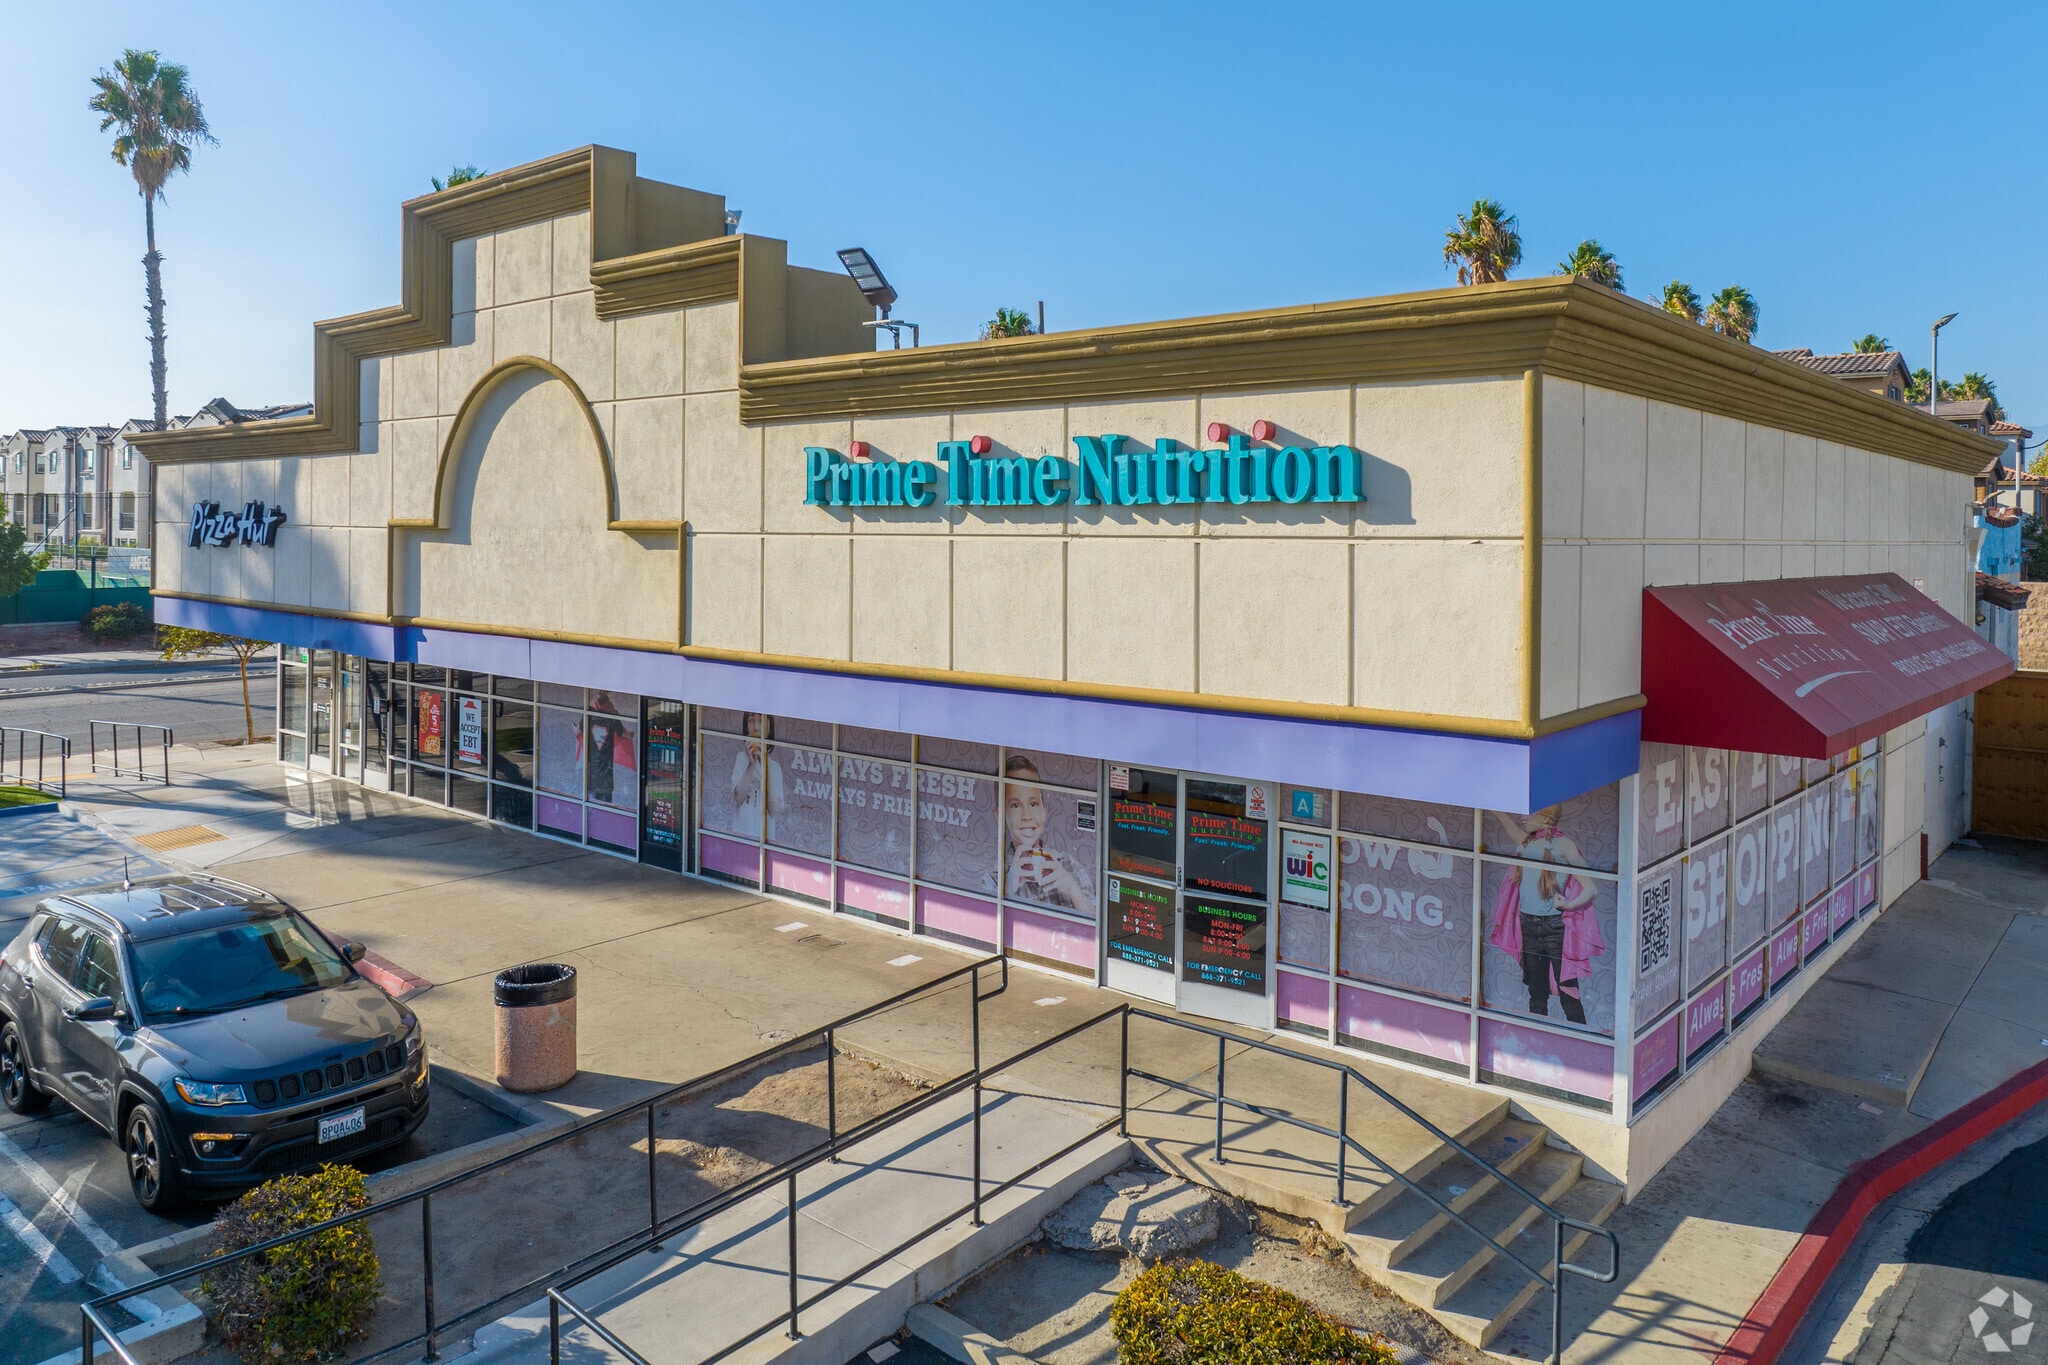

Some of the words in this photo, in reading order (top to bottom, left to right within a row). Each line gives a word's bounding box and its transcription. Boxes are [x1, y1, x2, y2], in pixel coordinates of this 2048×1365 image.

[803, 441, 937, 507] Prime
[938, 435, 1071, 507] Time
[1073, 419, 1367, 505] Nutrition
[188, 502, 237, 547] Pizza
[237, 502, 278, 546] Hut
[1706, 603, 1780, 649] Prime
[1753, 599, 1826, 635] Time
[1883, 615, 1920, 638] EBT
[1901, 611, 1950, 633] Benefits
[1851, 619, 1896, 645] SNAP
[1756, 643, 1860, 679] Nutrition
[466, 712, 475, 722] WE
[461, 723, 480, 734] ACCEPT
[463, 735, 477, 748] EBT
[791, 750, 884, 785] ALWAYS
[891, 766, 976, 801] FRESH
[793, 778, 867, 808] ALWAYS
[872, 792, 972, 828] FRIENDLY
[1115, 800, 1145, 814] Prime
[1147, 803, 1173, 819] Time
[1297, 798, 1309, 814] A
[1114, 812, 1174, 828] Nutrition
[1191, 813, 1227, 828] Prime
[1230, 817, 1261, 835] Time
[1190, 827, 1262, 843] Nutrition
[1119, 859, 1130, 868] NO
[1131, 862, 1165, 875] SOLICITORS
[1197, 878, 1209, 886] NO
[1211, 880, 1253, 893] SOLICITORS
[1120, 887, 1146, 899] BUSINESS
[1147, 893, 1168, 904] HOURS
[1129, 901, 1156, 912] MON-FRI
[1198, 905, 1231, 917] BUSINESS
[1232, 911, 1257, 922] HOURS
[1123, 915, 1134, 923] SAT
[1211, 920, 1243, 931] MON-FRI
[1122, 924, 1135, 933] SUN
[1210, 928, 1244, 940] 8:00-8:00
[1203, 935, 1216, 944] SAT
[1217, 939, 1250, 951] 9:00-4:00
[1776, 925, 1810, 967] Alwas
[1110, 941, 1121, 950] FOR
[1122, 945, 1157, 960] EMERGENCY
[1158, 955, 1173, 965] CALL
[1202, 944, 1216, 953] SUN
[1218, 948, 1251, 960] 9:00-4:00
[1186, 961, 1200, 970] FOR
[1201, 963, 1243, 976] EMERGENCY
[1244, 971, 1262, 980] CALL
[1201, 972, 1246, 986] 888-371-9521
[1655, 966, 1678, 992] Online
